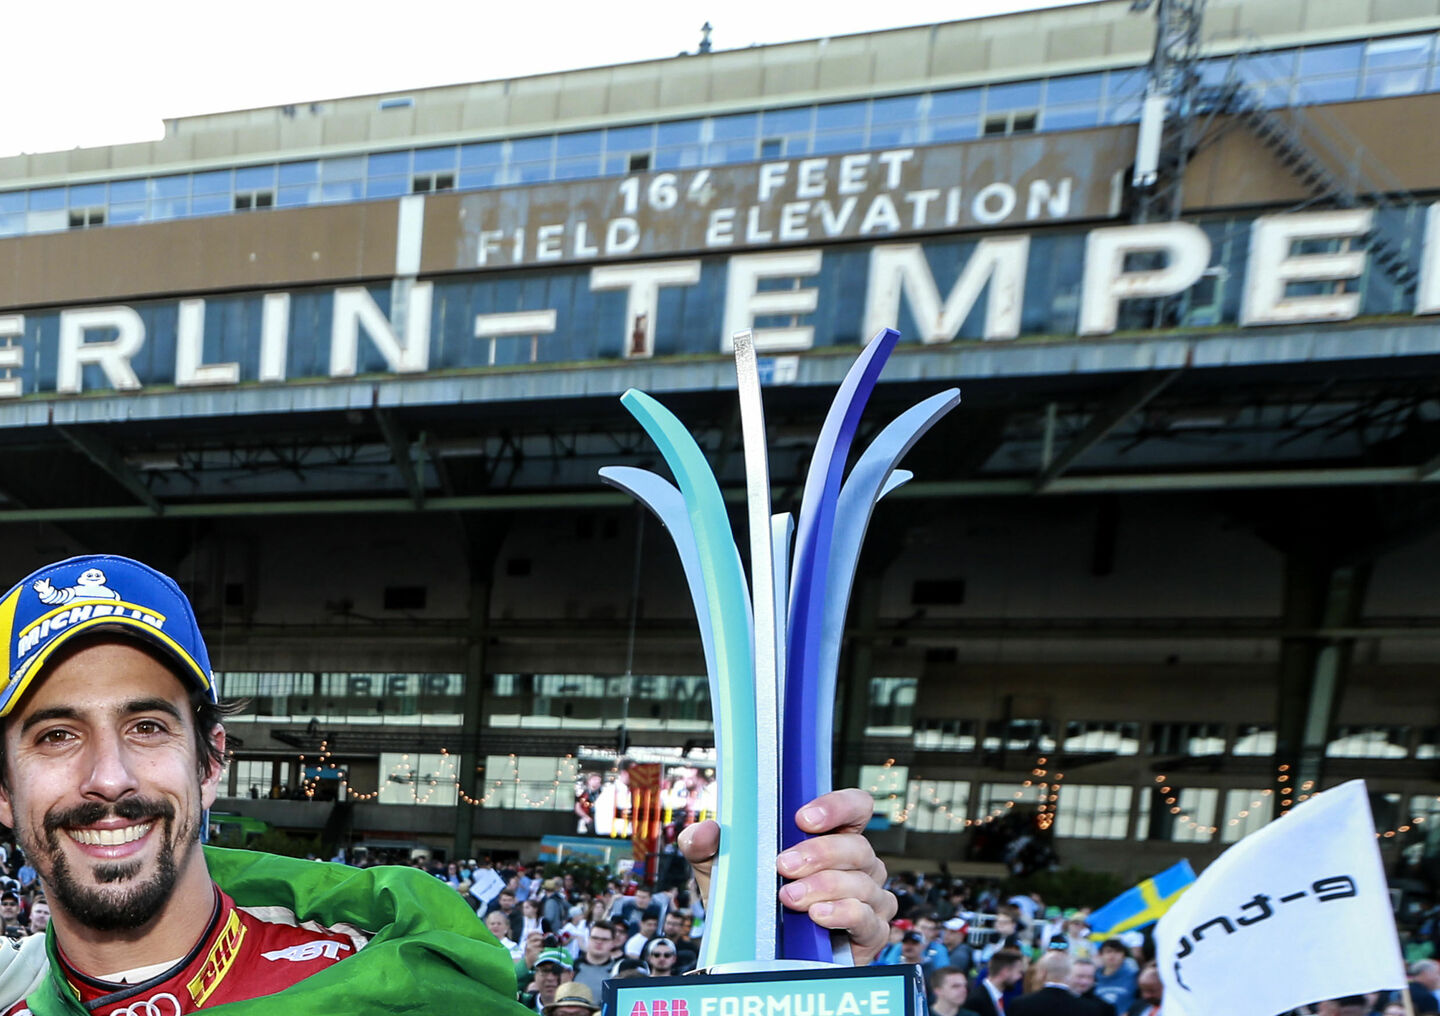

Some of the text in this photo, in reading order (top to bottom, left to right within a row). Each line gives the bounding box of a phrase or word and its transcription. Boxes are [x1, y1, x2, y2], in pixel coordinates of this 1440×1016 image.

[618, 149, 916, 215] 164 FEET
[476, 177, 1072, 267] FIELD ELEVATION
[17, 604, 164, 659] MICHELIN
[260, 939, 351, 962] ABT
